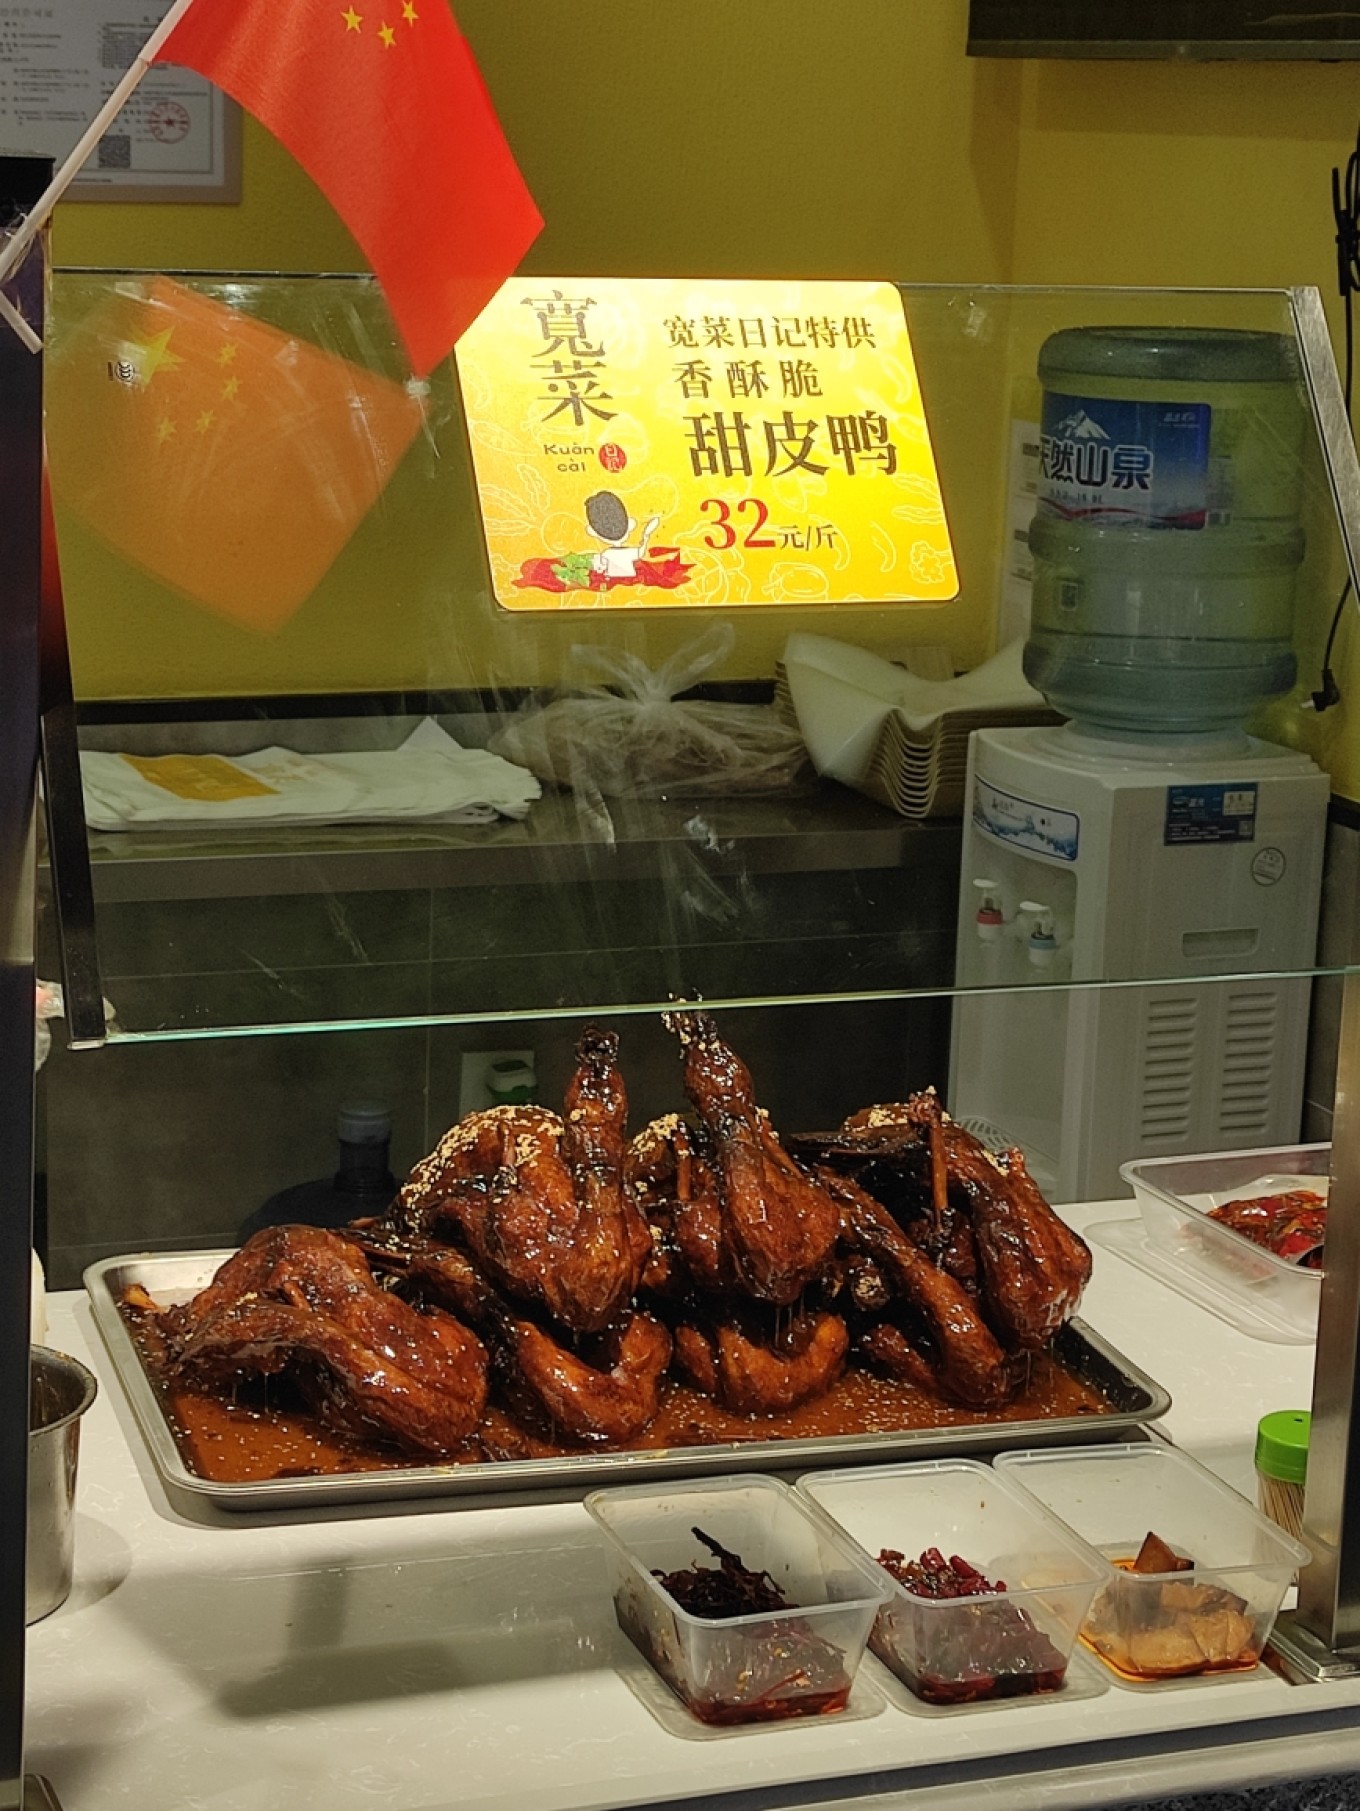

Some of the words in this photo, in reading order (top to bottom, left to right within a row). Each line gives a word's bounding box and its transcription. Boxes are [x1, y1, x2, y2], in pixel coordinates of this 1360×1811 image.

[663, 315, 877, 349] 宽菜日记特供
[672, 359, 823, 399] 香酥脆
[683, 410, 898, 477] 甜皮鸭
